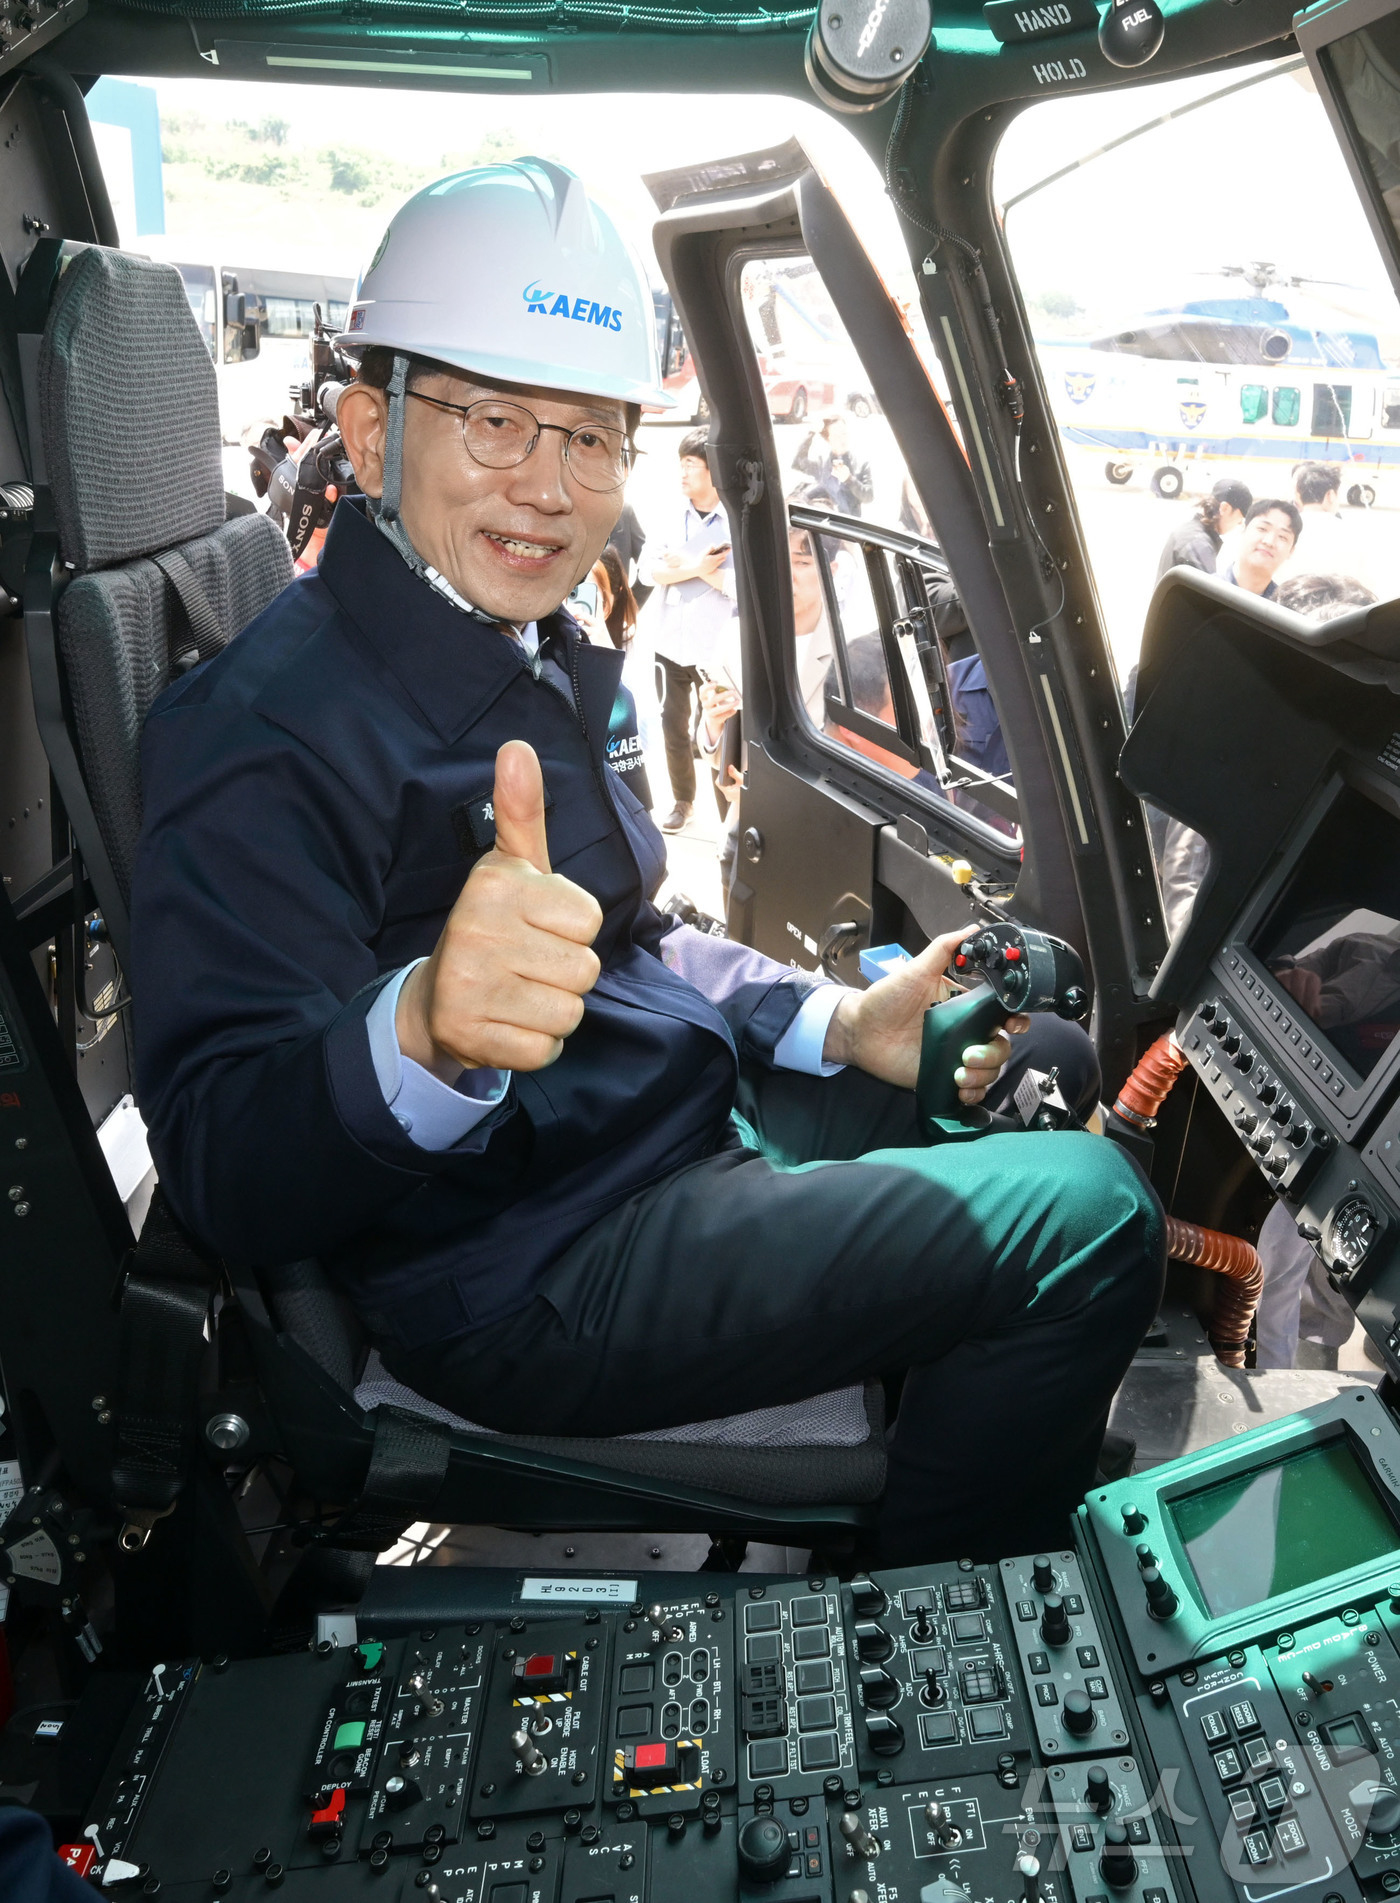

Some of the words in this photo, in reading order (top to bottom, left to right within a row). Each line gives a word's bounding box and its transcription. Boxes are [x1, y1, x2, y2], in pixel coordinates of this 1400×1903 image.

[1014, 3, 1072, 33] HAND
[1121, 8, 1153, 32] FUEL
[1032, 58, 1087, 84] HOLD
[522, 279, 622, 332] KAEMS
[985, 1583, 995, 1604] ON/OFF
[892, 1595, 900, 1609] FCP
[1069, 1597, 1078, 1609] CLR
[689, 1621, 697, 1643] ARMED
[835, 1626, 843, 1642] AUTO
[985, 1619, 993, 1634] COMP
[652, 1630, 660, 1643] OFF
[936, 1636, 942, 1645] RH
[1322, 1624, 1368, 1646] BLADE
[837, 1642, 845, 1657] TRIM
[852, 1639, 860, 1661] BACKUP
[899, 1635, 907, 1654] AHRS
[626, 1652, 650, 1660] ARM
[712, 1658, 721, 1669] LH
[580, 1656, 589, 1677] CABLE
[1365, 1650, 1387, 1683] POWER
[346, 1678, 381, 1688] TRANSMIT
[833, 1668, 841, 1683] PITCH
[1004, 1671, 1015, 1695] ON/OFF
[1197, 1672, 1244, 1692] CONTROL
[1338, 1674, 1348, 1686] ON
[580, 1679, 588, 1692] CUT
[696, 1684, 704, 1697] FWD
[712, 1681, 722, 1695] BTL
[905, 1682, 913, 1697] ADC
[1042, 1684, 1050, 1701] PROC
[1089, 1680, 1097, 1693] NAV
[1095, 1679, 1104, 1694] COM
[370, 1686, 382, 1712] TX/TEST
[856, 1684, 865, 1707] BACKUP
[1297, 1687, 1308, 1702] OFF
[451, 1701, 457, 1711] ON
[461, 1697, 471, 1725] MASTER
[947, 1700, 953, 1710] RH
[1241, 1703, 1253, 1723] ZOOM
[328, 1707, 336, 1720] CPI
[572, 1711, 581, 1730] PILOT
[712, 1709, 721, 1720] RH
[843, 1712, 851, 1728] TRIM
[1005, 1712, 1014, 1730] COMP
[1234, 1707, 1245, 1725] RESET
[521, 1716, 529, 1733] DOW
[556, 1718, 562, 1727] UP
[562, 1706, 572, 1738] OVERRIDE
[1208, 1715, 1219, 1736] COLOR
[1371, 1721, 1382, 1733] #2
[366, 1720, 376, 1741] RESET
[844, 1728, 853, 1744] FEEL
[315, 1720, 333, 1765] CONTROLLER
[839, 1744, 848, 1755] CYC
[1307, 1730, 1331, 1771] GROUND
[1379, 1737, 1395, 1759] AUTO
[354, 1753, 364, 1774] GONE
[360, 1748, 372, 1778] BEACON
[423, 1746, 433, 1767] INJECT
[443, 1748, 452, 1768] EMPTY
[461, 1747, 469, 1765] FOAM
[551, 1757, 557, 1768] ON
[558, 1747, 568, 1776] ENABLE
[568, 1750, 576, 1770] HOIST
[701, 1751, 709, 1774] FLOAT
[1218, 1759, 1228, 1775] CAM
[1283, 1756, 1297, 1775] UPD
[1383, 1767, 1398, 1787] TEST
[321, 1781, 352, 1791] DEPLOY
[438, 1784, 446, 1794] ON
[456, 1777, 464, 1796] PUMP
[902, 1786, 962, 1801] FUEL
[131, 1795, 140, 1807] AUX
[1120, 1784, 1132, 1807] RANGE
[368, 1790, 380, 1820] PERCENT
[106, 1818, 116, 1830] REC
[868, 1808, 879, 1831] XFER
[1341, 1808, 1362, 1840] MODE
[965, 1829, 974, 1840] ON
[1077, 1829, 1086, 1843] ENT
[1132, 1822, 1142, 1836] CLR
[1287, 1823, 1301, 1846] ZOOM
[884, 1839, 891, 1851] ON
[926, 1832, 936, 1846] OFF
[112, 1842, 122, 1855] VOL
[589, 1844, 632, 1855] AVCS
[1246, 1837, 1260, 1862] ZOOM
[443, 1865, 478, 1877] ECP
[488, 1860, 524, 1871] MPP
[867, 1862, 877, 1882] AUTO
[1139, 1859, 1149, 1875] PFD
[465, 1888, 474, 1902] ATC
[962, 1883, 971, 1893] LH
